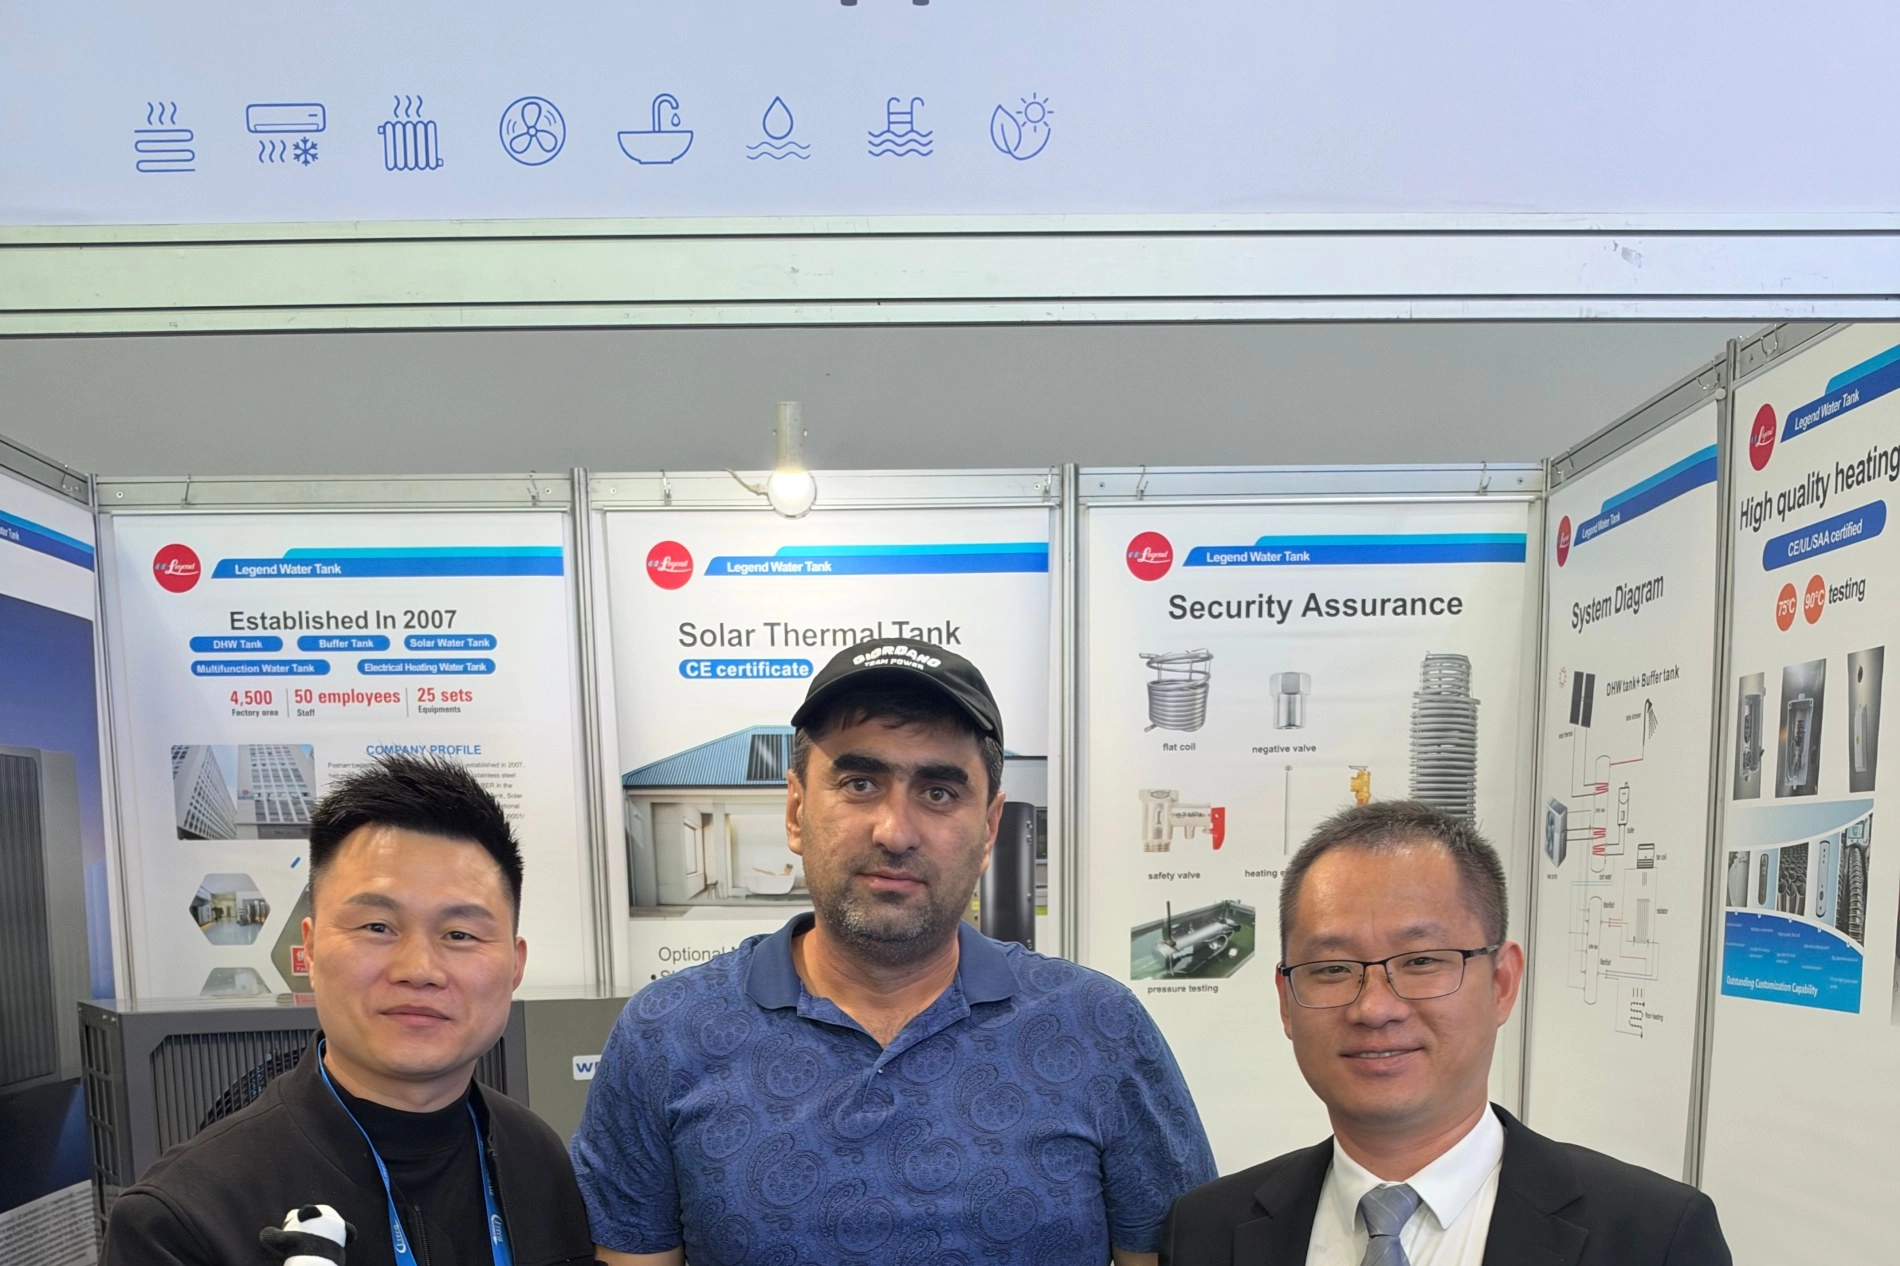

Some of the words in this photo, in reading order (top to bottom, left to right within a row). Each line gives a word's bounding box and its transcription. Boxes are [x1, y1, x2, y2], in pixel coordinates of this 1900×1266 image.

[1794, 409, 1820, 431] Legend
[1821, 399, 1841, 419] Water
[1842, 388, 1859, 408] Tank
[1740, 490, 1773, 533] High
[1777, 471, 1830, 523] quality
[1834, 445, 1900, 495] heating
[1788, 530, 1830, 557] CE/UL/SAA
[1830, 518, 1863, 543] certified
[1206, 552, 1248, 565] Legend
[1249, 552, 1282, 563] Water
[1284, 551, 1310, 562] Tank
[234, 564, 276, 578] Legend
[279, 563, 311, 575] Water
[314, 563, 342, 575] Tank
[727, 562, 769, 575] Legend
[770, 562, 804, 573] Water
[805, 561, 832, 572] Tank
[1828, 577, 1866, 605] testing
[1168, 593, 1293, 625] Security
[1301, 592, 1464, 618] Assurance
[1571, 595, 1612, 634] System
[1614, 575, 1664, 615] Diagram
[230, 610, 368, 631] Established
[376, 610, 397, 630] In
[403, 609, 457, 629] 2007
[678, 622, 756, 648] Solar
[763, 621, 882, 647] Thermal
[892, 620, 962, 645] Tank
[213, 640, 238, 649] DHW
[240, 639, 263, 649] Tank
[319, 639, 349, 648] Buffer
[351, 639, 374, 648] Tank
[409, 639, 435, 648] Solar
[437, 638, 464, 648] Water
[466, 638, 490, 647] Tank
[853, 645, 941, 668] GIORDANO
[197, 664, 259, 674] Multifunction
[261, 664, 289, 673] Water
[291, 663, 315, 673] Tank
[364, 663, 403, 672] Electrical
[404, 663, 437, 673] Heating
[439, 662, 465, 672] Water
[466, 662, 487, 671] Tank
[685, 661, 712, 677] CE
[716, 661, 810, 677] certificate
[864, 658, 889, 667] TEAM
[890, 658, 924, 670] POWER
[1606, 680, 1622, 697] DHW
[1641, 669, 1662, 688] Buffer
[1663, 664, 1680, 682] tank
[230, 690, 273, 707] 4,500
[294, 688, 313, 704] 50
[318, 688, 401, 707] employees
[417, 687, 436, 703] 25
[441, 688, 473, 703] sets
[232, 708, 260, 718] Factory
[262, 709, 279, 717] area
[297, 708, 315, 717] Staff
[418, 705, 461, 714] Equipments
[366, 745, 426, 756] COMPANY
[430, 744, 482, 755] PROFILE
[1162, 743, 1177, 751] flat
[1179, 743, 1196, 751] coil
[1252, 744, 1290, 755] negative
[1293, 743, 1317, 753] valve
[1148, 871, 1175, 881] safety
[1177, 871, 1201, 880] valve
[1244, 869, 1278, 879] heating
[1147, 985, 1186, 994] pressure
[1188, 984, 1219, 994] testing
